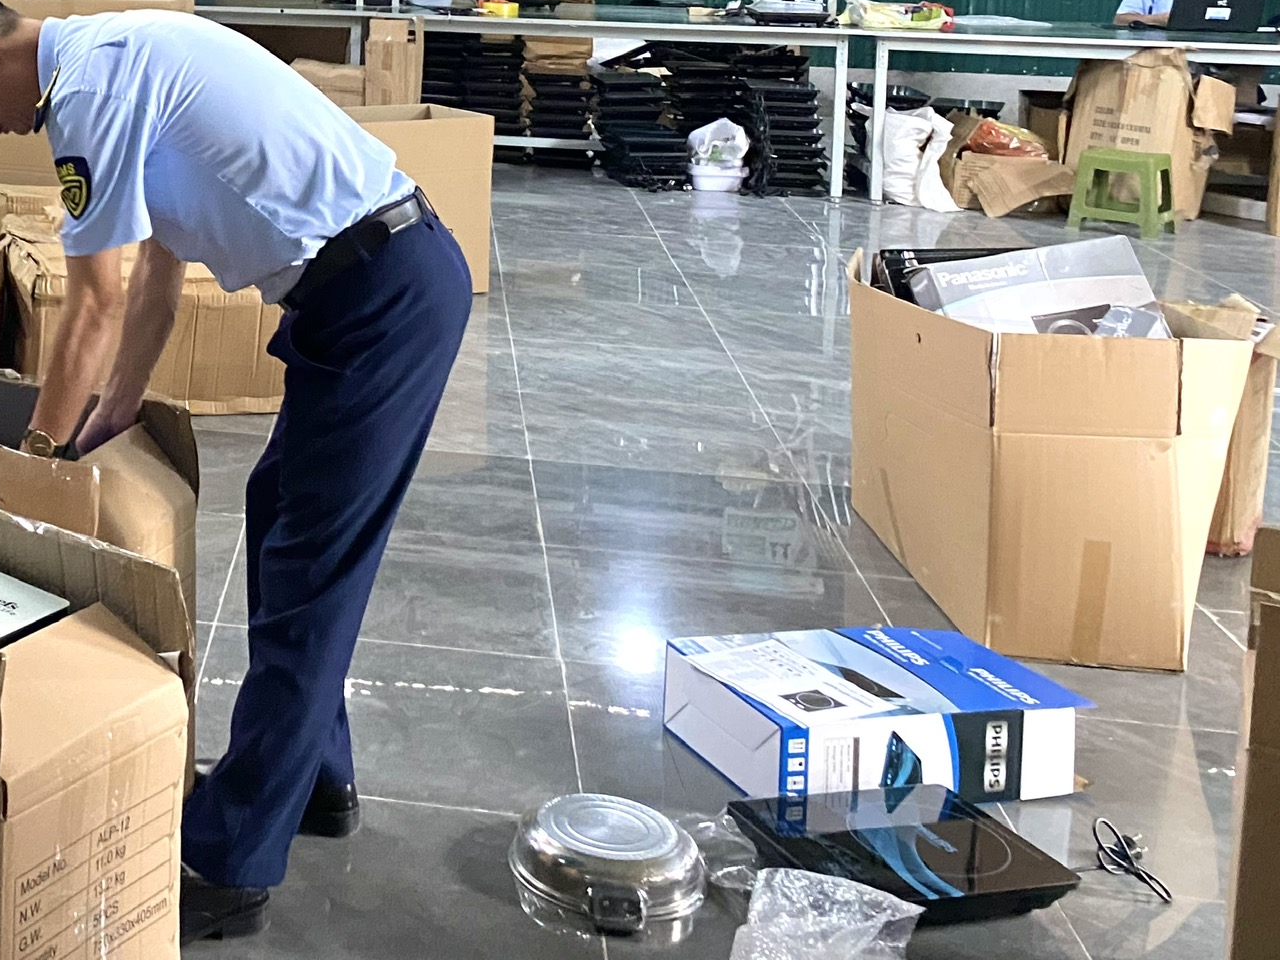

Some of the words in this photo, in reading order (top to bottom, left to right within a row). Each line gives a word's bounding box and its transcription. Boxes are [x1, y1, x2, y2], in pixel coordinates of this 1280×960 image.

[937, 260, 1029, 288] Panasonic
[865, 630, 931, 666] PHILIPS
[967, 667, 1041, 705] PHILIPS
[988, 725, 1003, 789] PHILIPS
[96, 816, 131, 848] ALP-12
[114, 844, 127, 861] kg
[20, 865, 51, 897] Model
[114, 870, 126, 886] kg
[92, 900, 120, 928] 5CS
